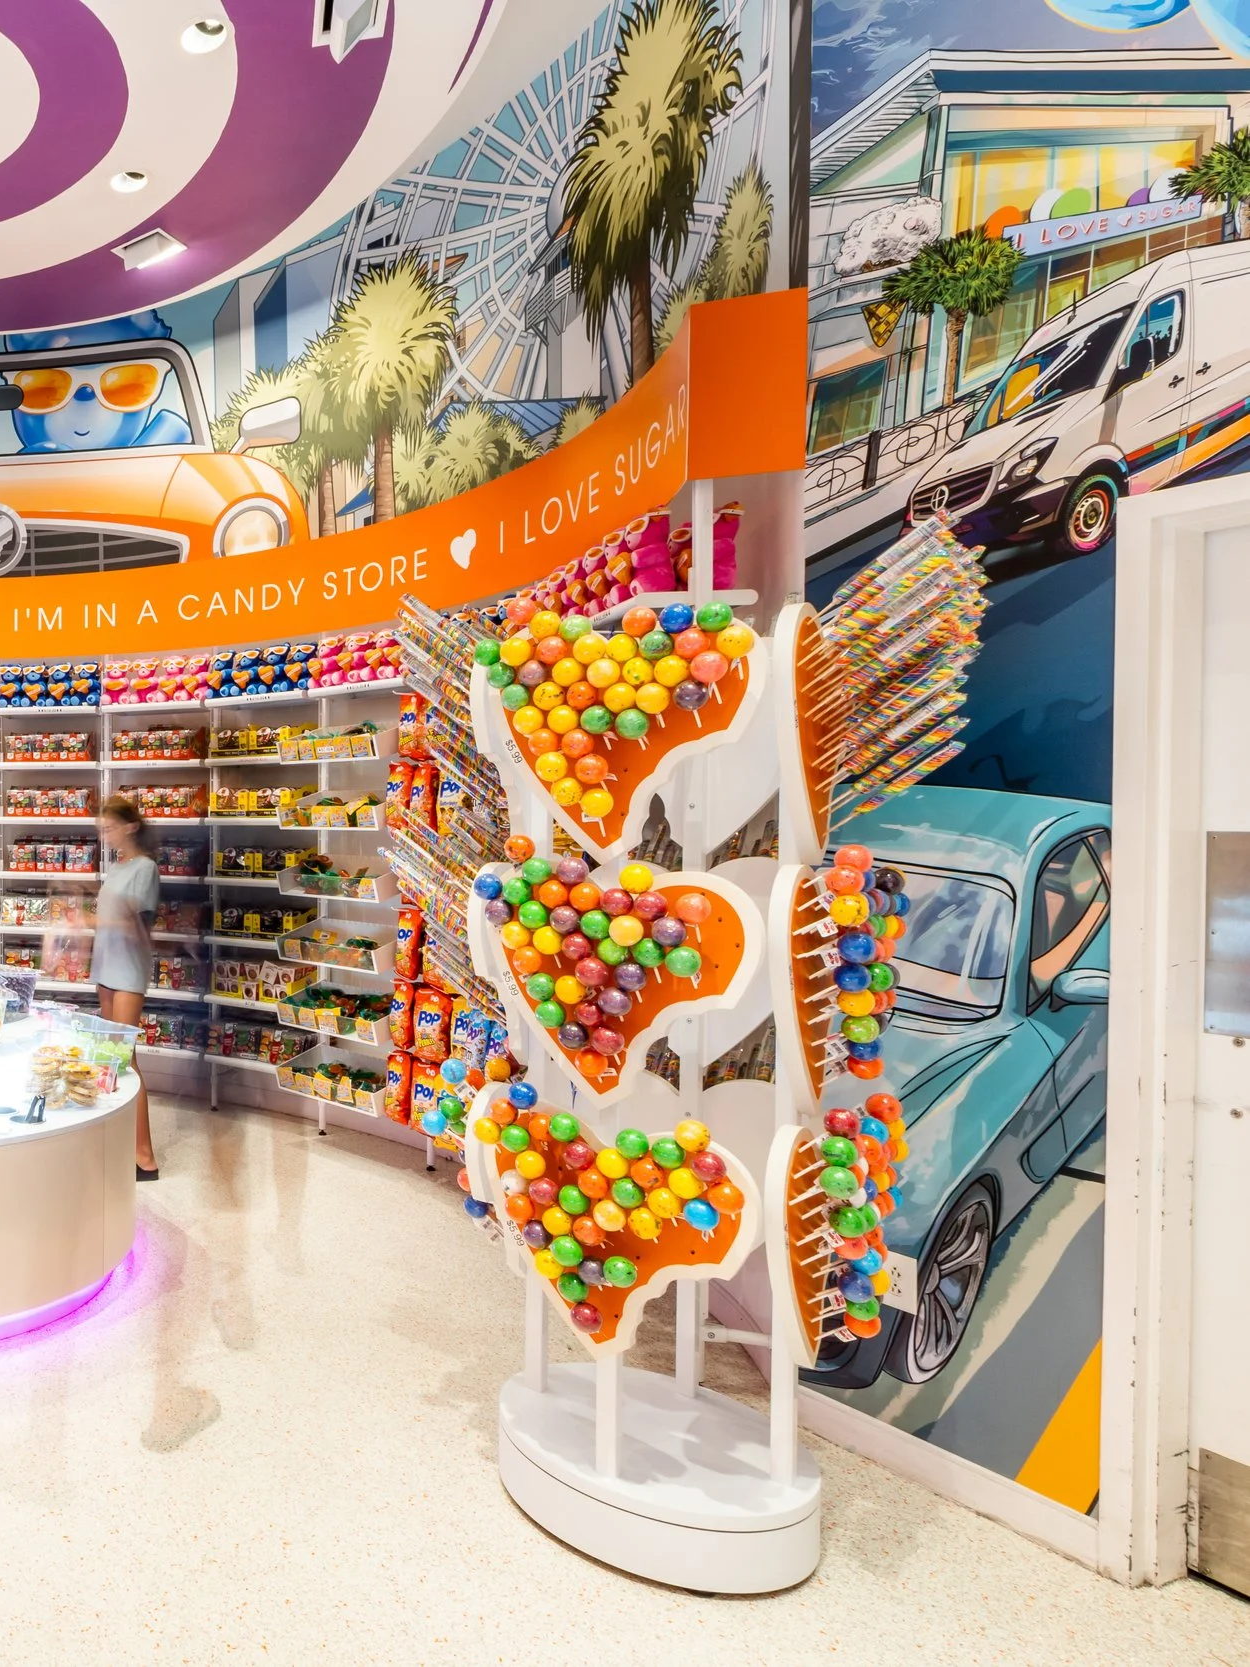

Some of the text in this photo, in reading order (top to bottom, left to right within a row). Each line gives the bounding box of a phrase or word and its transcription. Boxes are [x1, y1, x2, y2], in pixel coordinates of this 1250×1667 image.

[1015, 201, 1196, 249] I LOVE SUGAR
[499, 383, 686, 554] I LOVE SUGAR
[13, 605, 63, 632] I'M
[83, 603, 117, 629] IN
[137, 599, 159, 625] A
[177, 576, 307, 622] CANDY
[322, 547, 429, 600] STORE
[505, 739, 523, 764] $5.99
[502, 970, 519, 996] $5.99
[418, 1011, 441, 1027] POP
[454, 1018, 469, 1034] PO
[506, 1219, 525, 1247] $5.99
